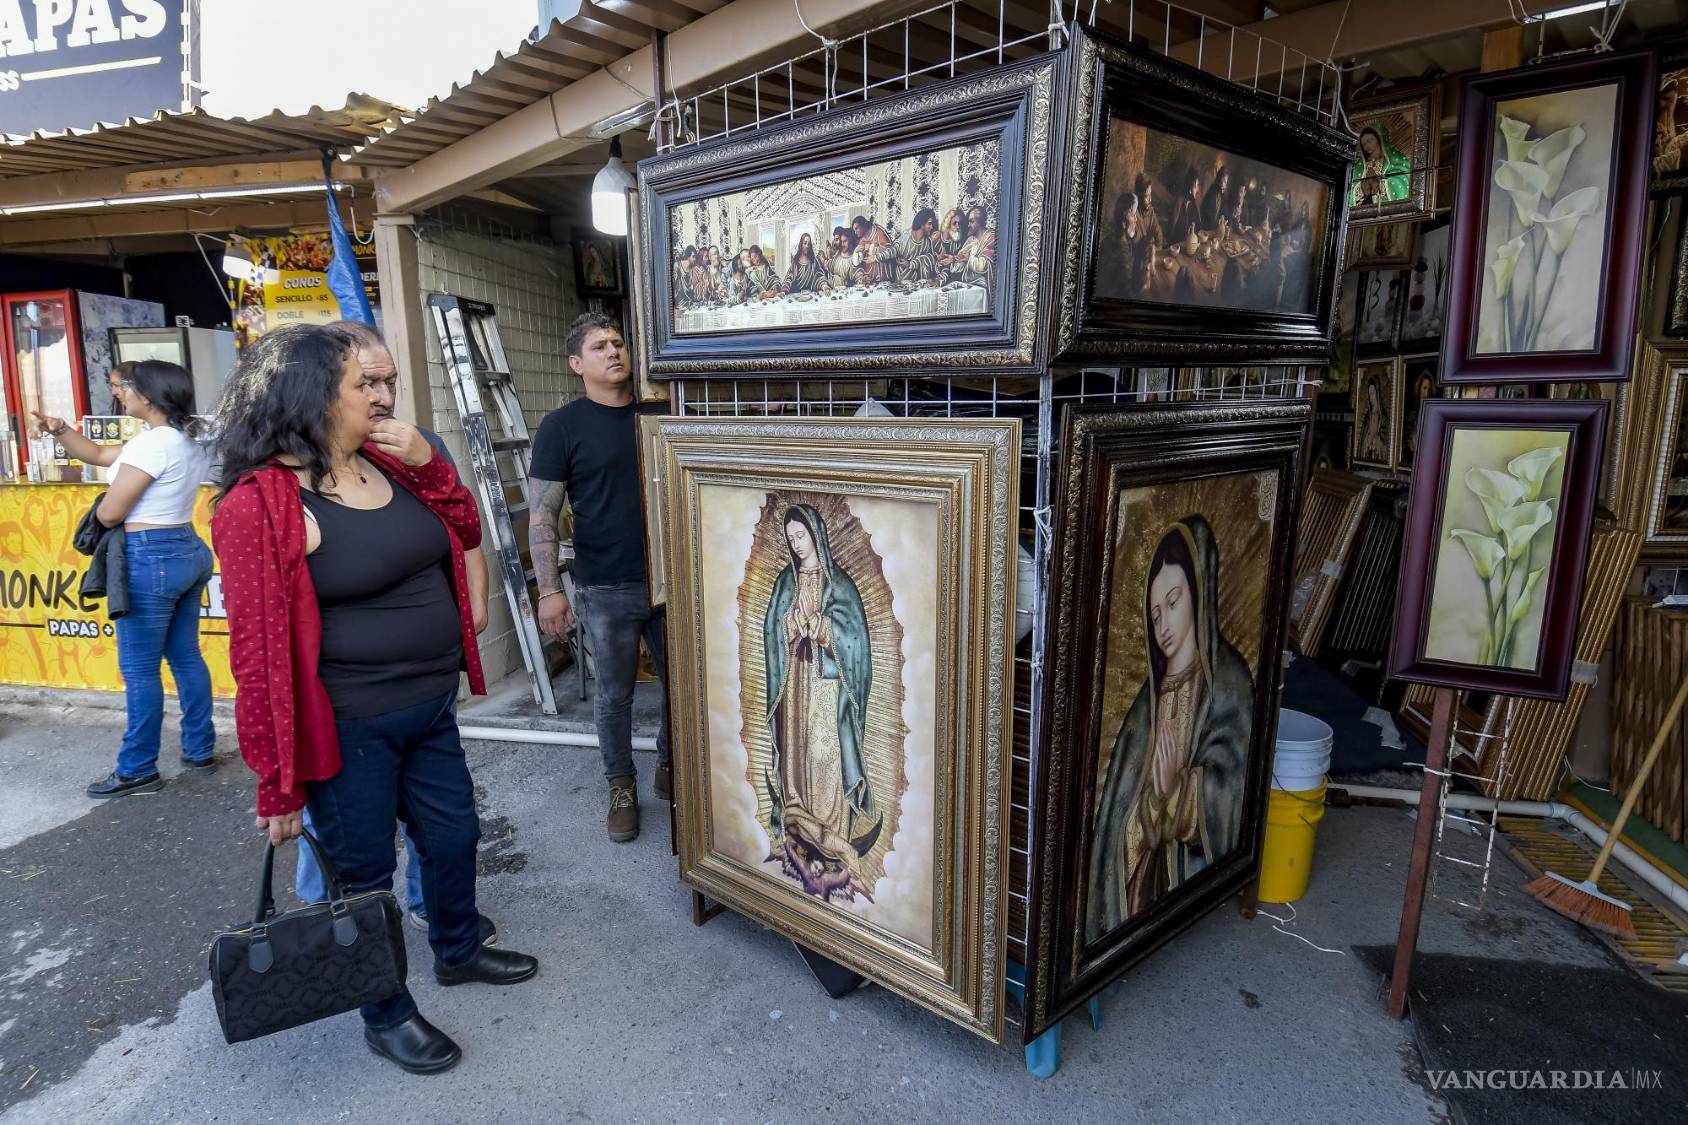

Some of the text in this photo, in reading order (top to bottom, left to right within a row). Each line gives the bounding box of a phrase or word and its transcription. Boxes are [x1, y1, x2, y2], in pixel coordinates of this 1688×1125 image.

[284, 277, 321, 289] CONOS
[275, 294, 313, 303] SENCILLO
[48, 619, 99, 638] PAPAS
